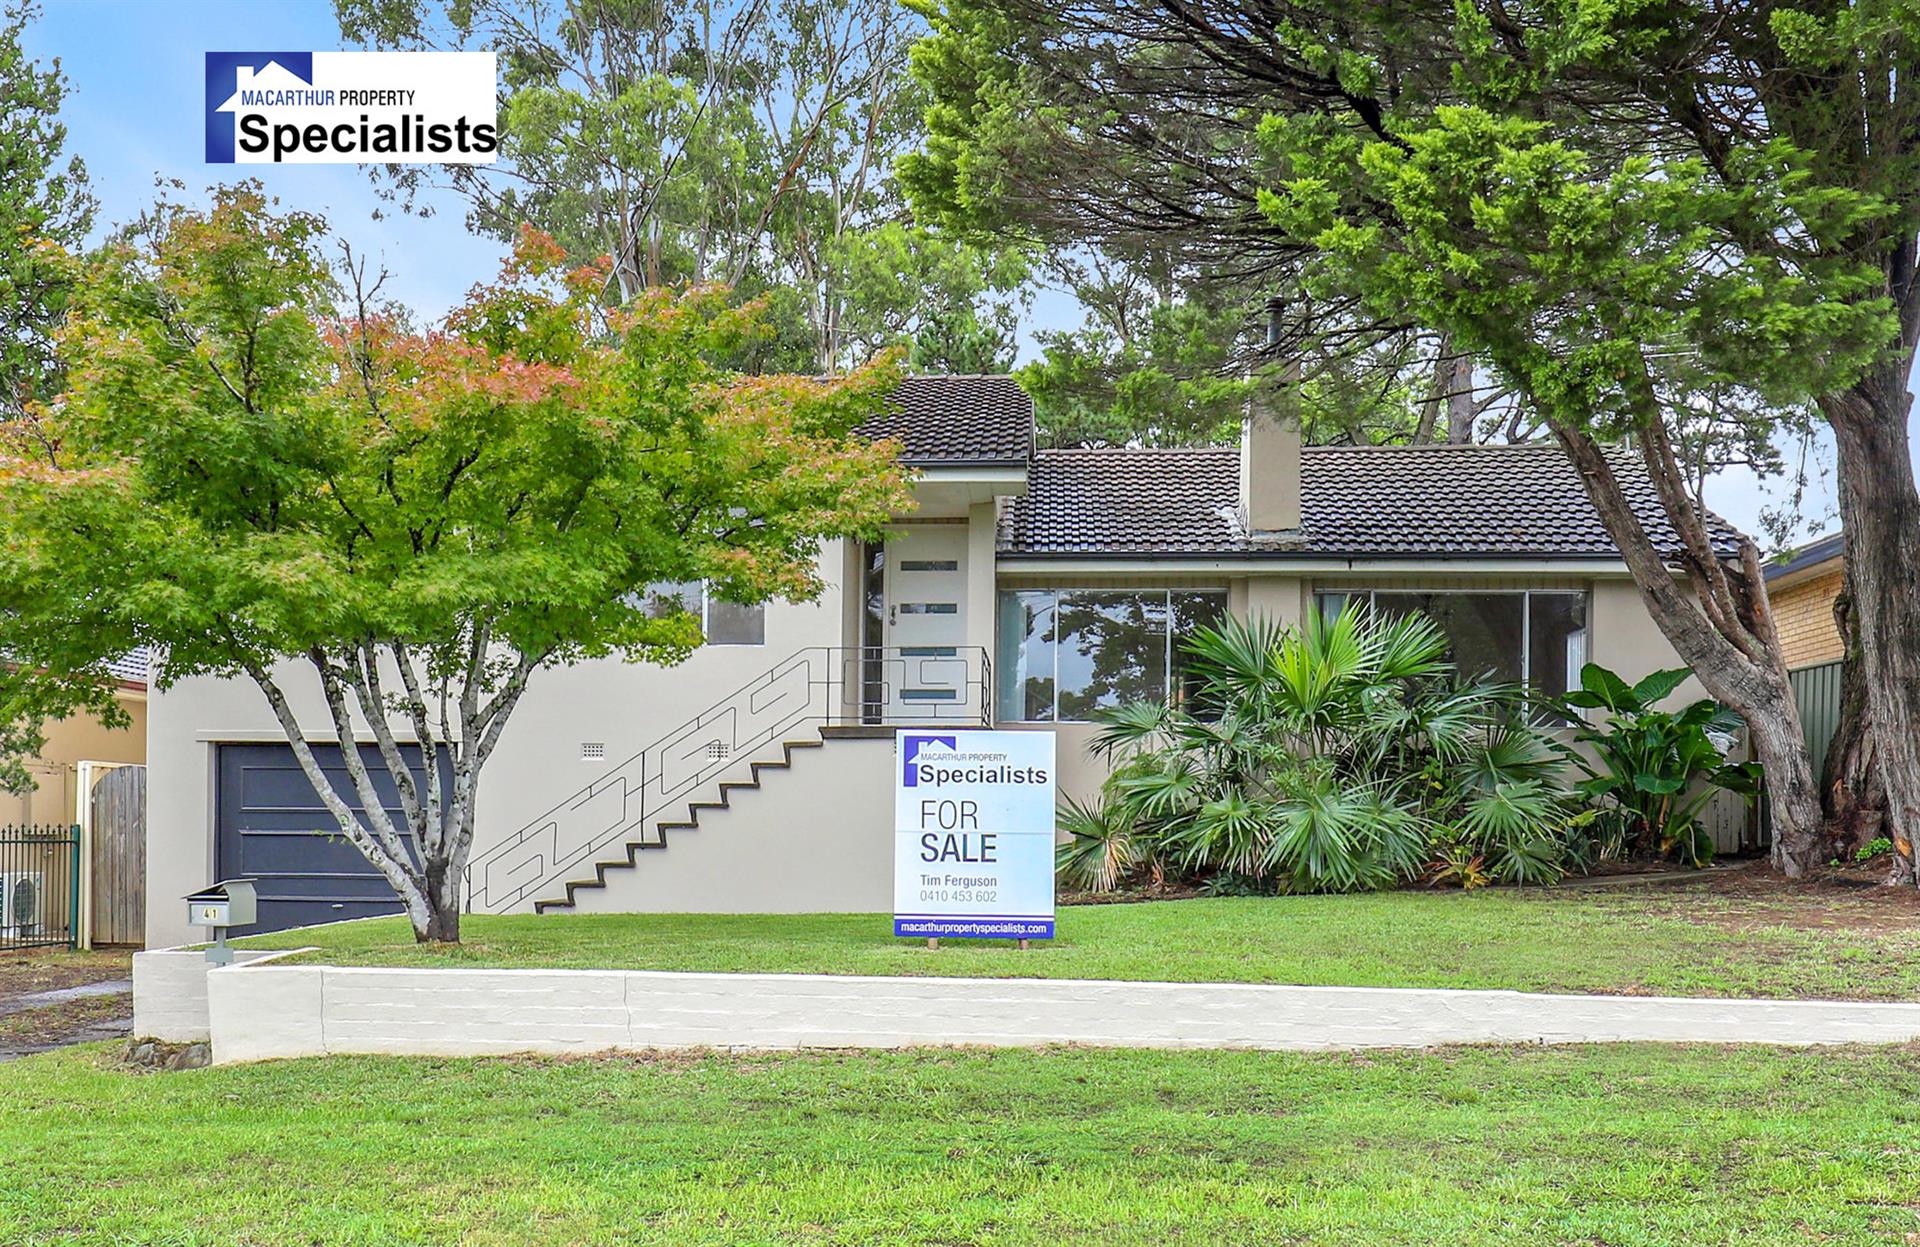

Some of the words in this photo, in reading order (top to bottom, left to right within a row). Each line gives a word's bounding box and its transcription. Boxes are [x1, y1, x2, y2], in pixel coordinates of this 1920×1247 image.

[920, 753, 967, 762] MACARTHUR
[968, 753, 1008, 762] PROPERTY
[920, 764, 1048, 787] Specialists
[921, 800, 978, 829] FOR
[920, 833, 997, 863] SALE
[920, 874, 941, 886] Tim
[944, 874, 997, 889] Ferguson
[920, 890, 948, 902] 0410
[951, 890, 973, 902] 453
[975, 890, 997, 903] 602
[203, 909, 217, 918] 41
[900, 922, 1047, 935] macarthurpropertyspecialists.com
